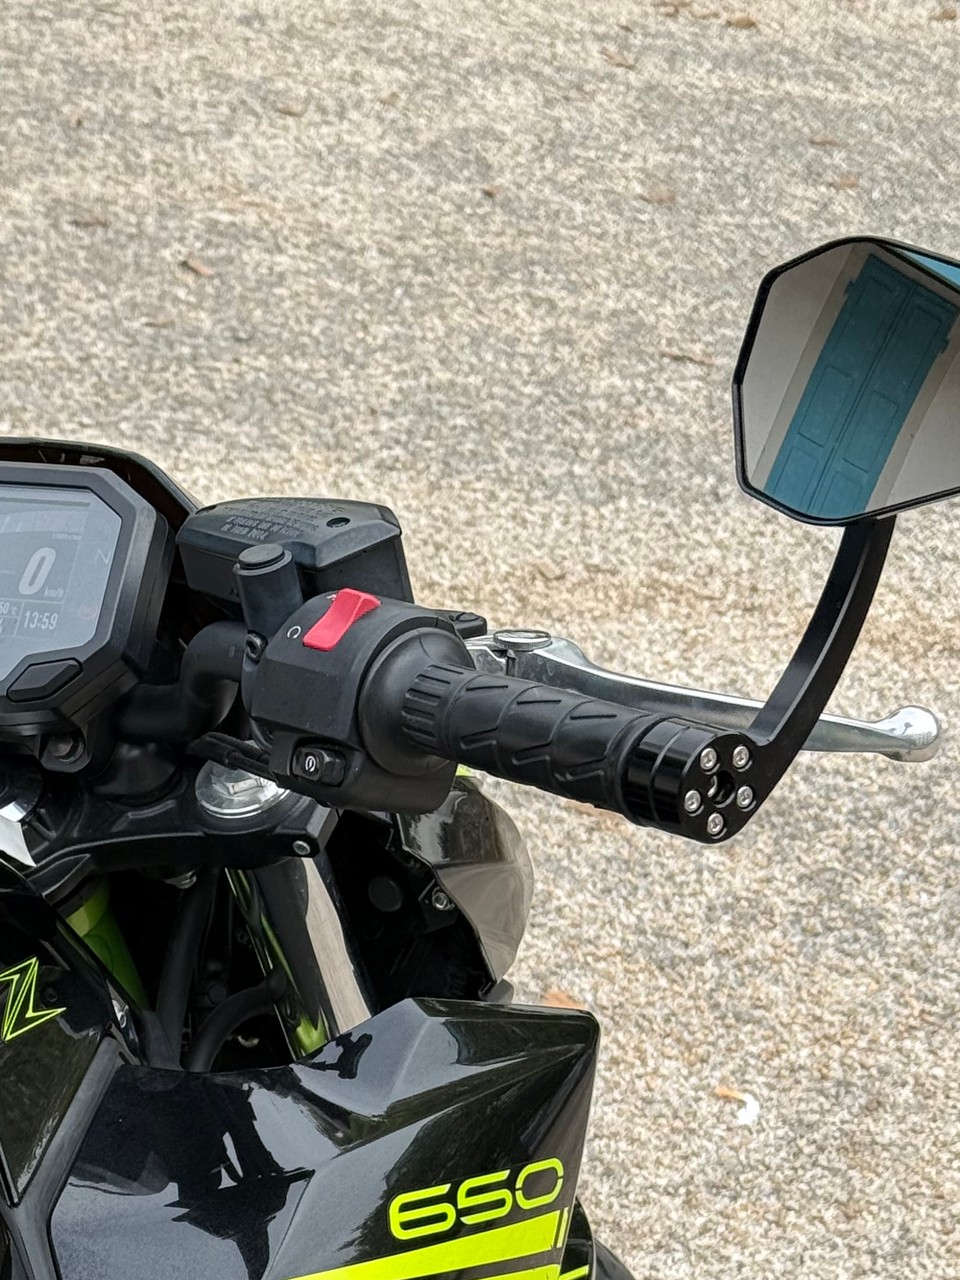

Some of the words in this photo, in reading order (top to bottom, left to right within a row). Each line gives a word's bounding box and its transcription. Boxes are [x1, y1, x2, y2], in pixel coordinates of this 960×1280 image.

[19, 547, 56, 595] 0
[23, 610, 59, 631] 13:59
[388, 1156, 565, 1241] 650
